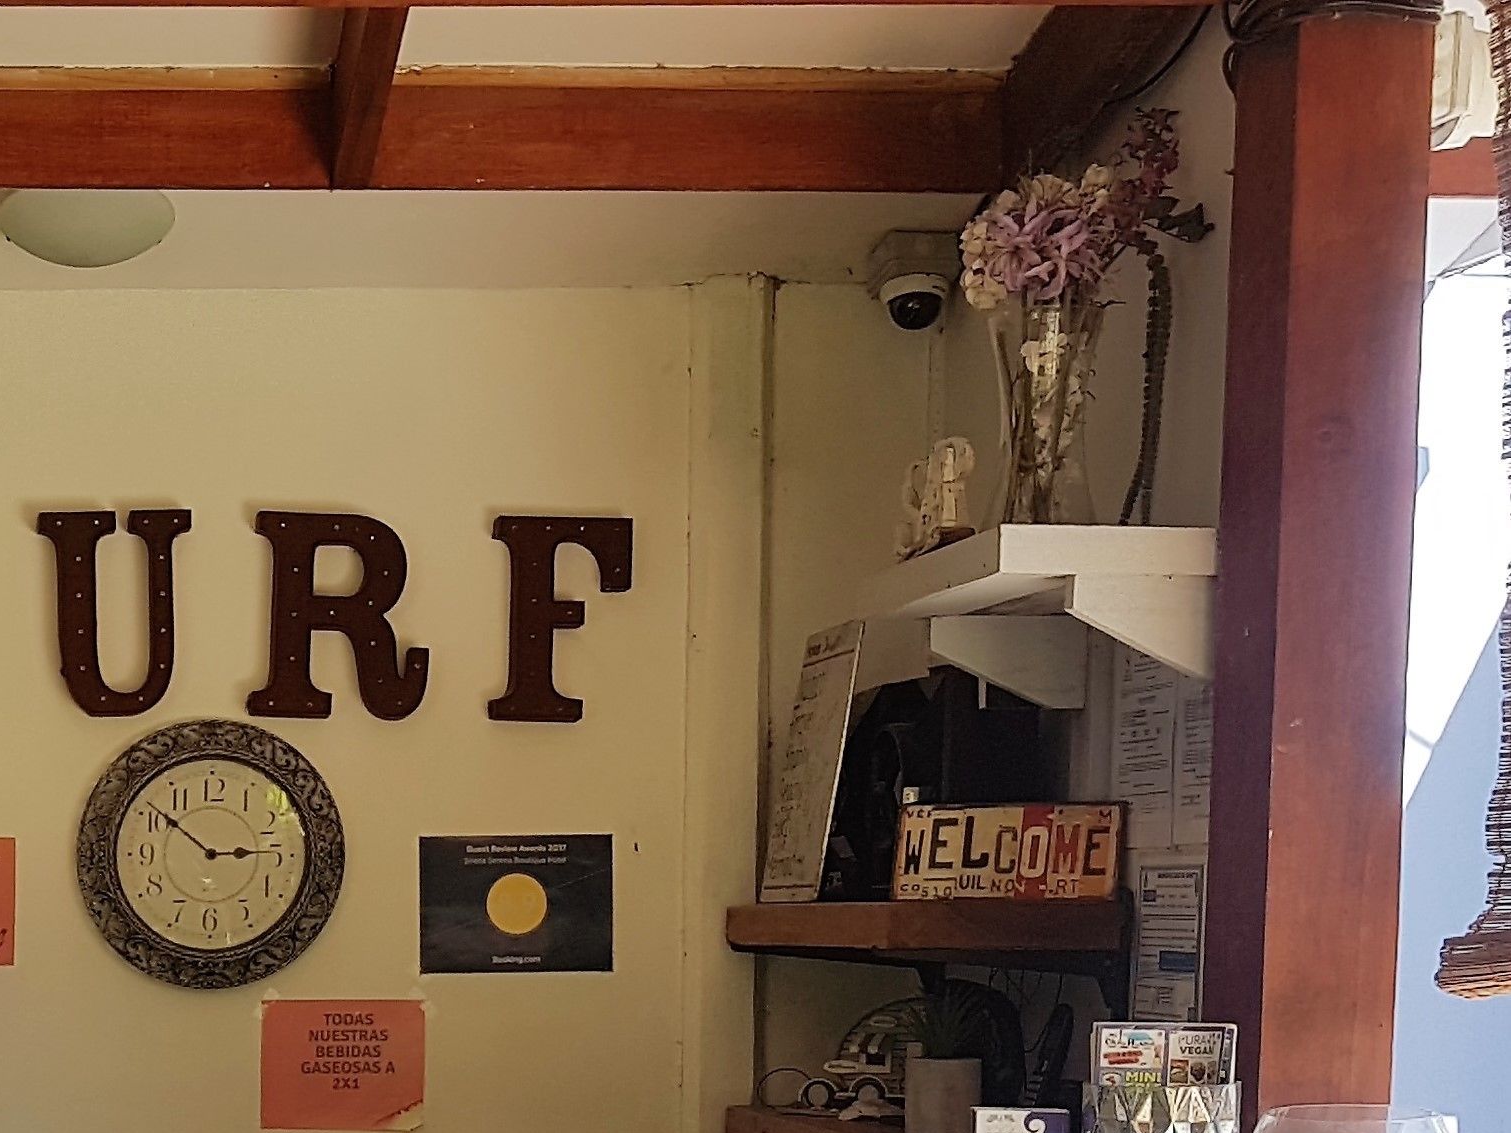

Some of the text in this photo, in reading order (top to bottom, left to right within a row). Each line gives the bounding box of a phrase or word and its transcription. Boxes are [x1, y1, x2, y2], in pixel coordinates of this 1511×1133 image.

[203, 778, 225, 802] 12
[172, 788, 188, 811] 11
[903, 814, 1111, 879] WELCOME
[139, 842, 155, 866] 9
[146, 873, 163, 897] 8
[202, 907, 218, 932] 6
[492, 955, 541, 965] Booking.com
[324, 1013, 374, 1026] TODAS
[308, 1029, 388, 1042] NUESTRAS
[315, 1045, 381, 1058] BEBIDAS
[1180, 1046, 1214, 1055] VEGAN
[301, 1061, 395, 1074] GASEOSAS A
[332, 1077, 360, 1090] 2X1
[1125, 1071, 1162, 1083] MINI
